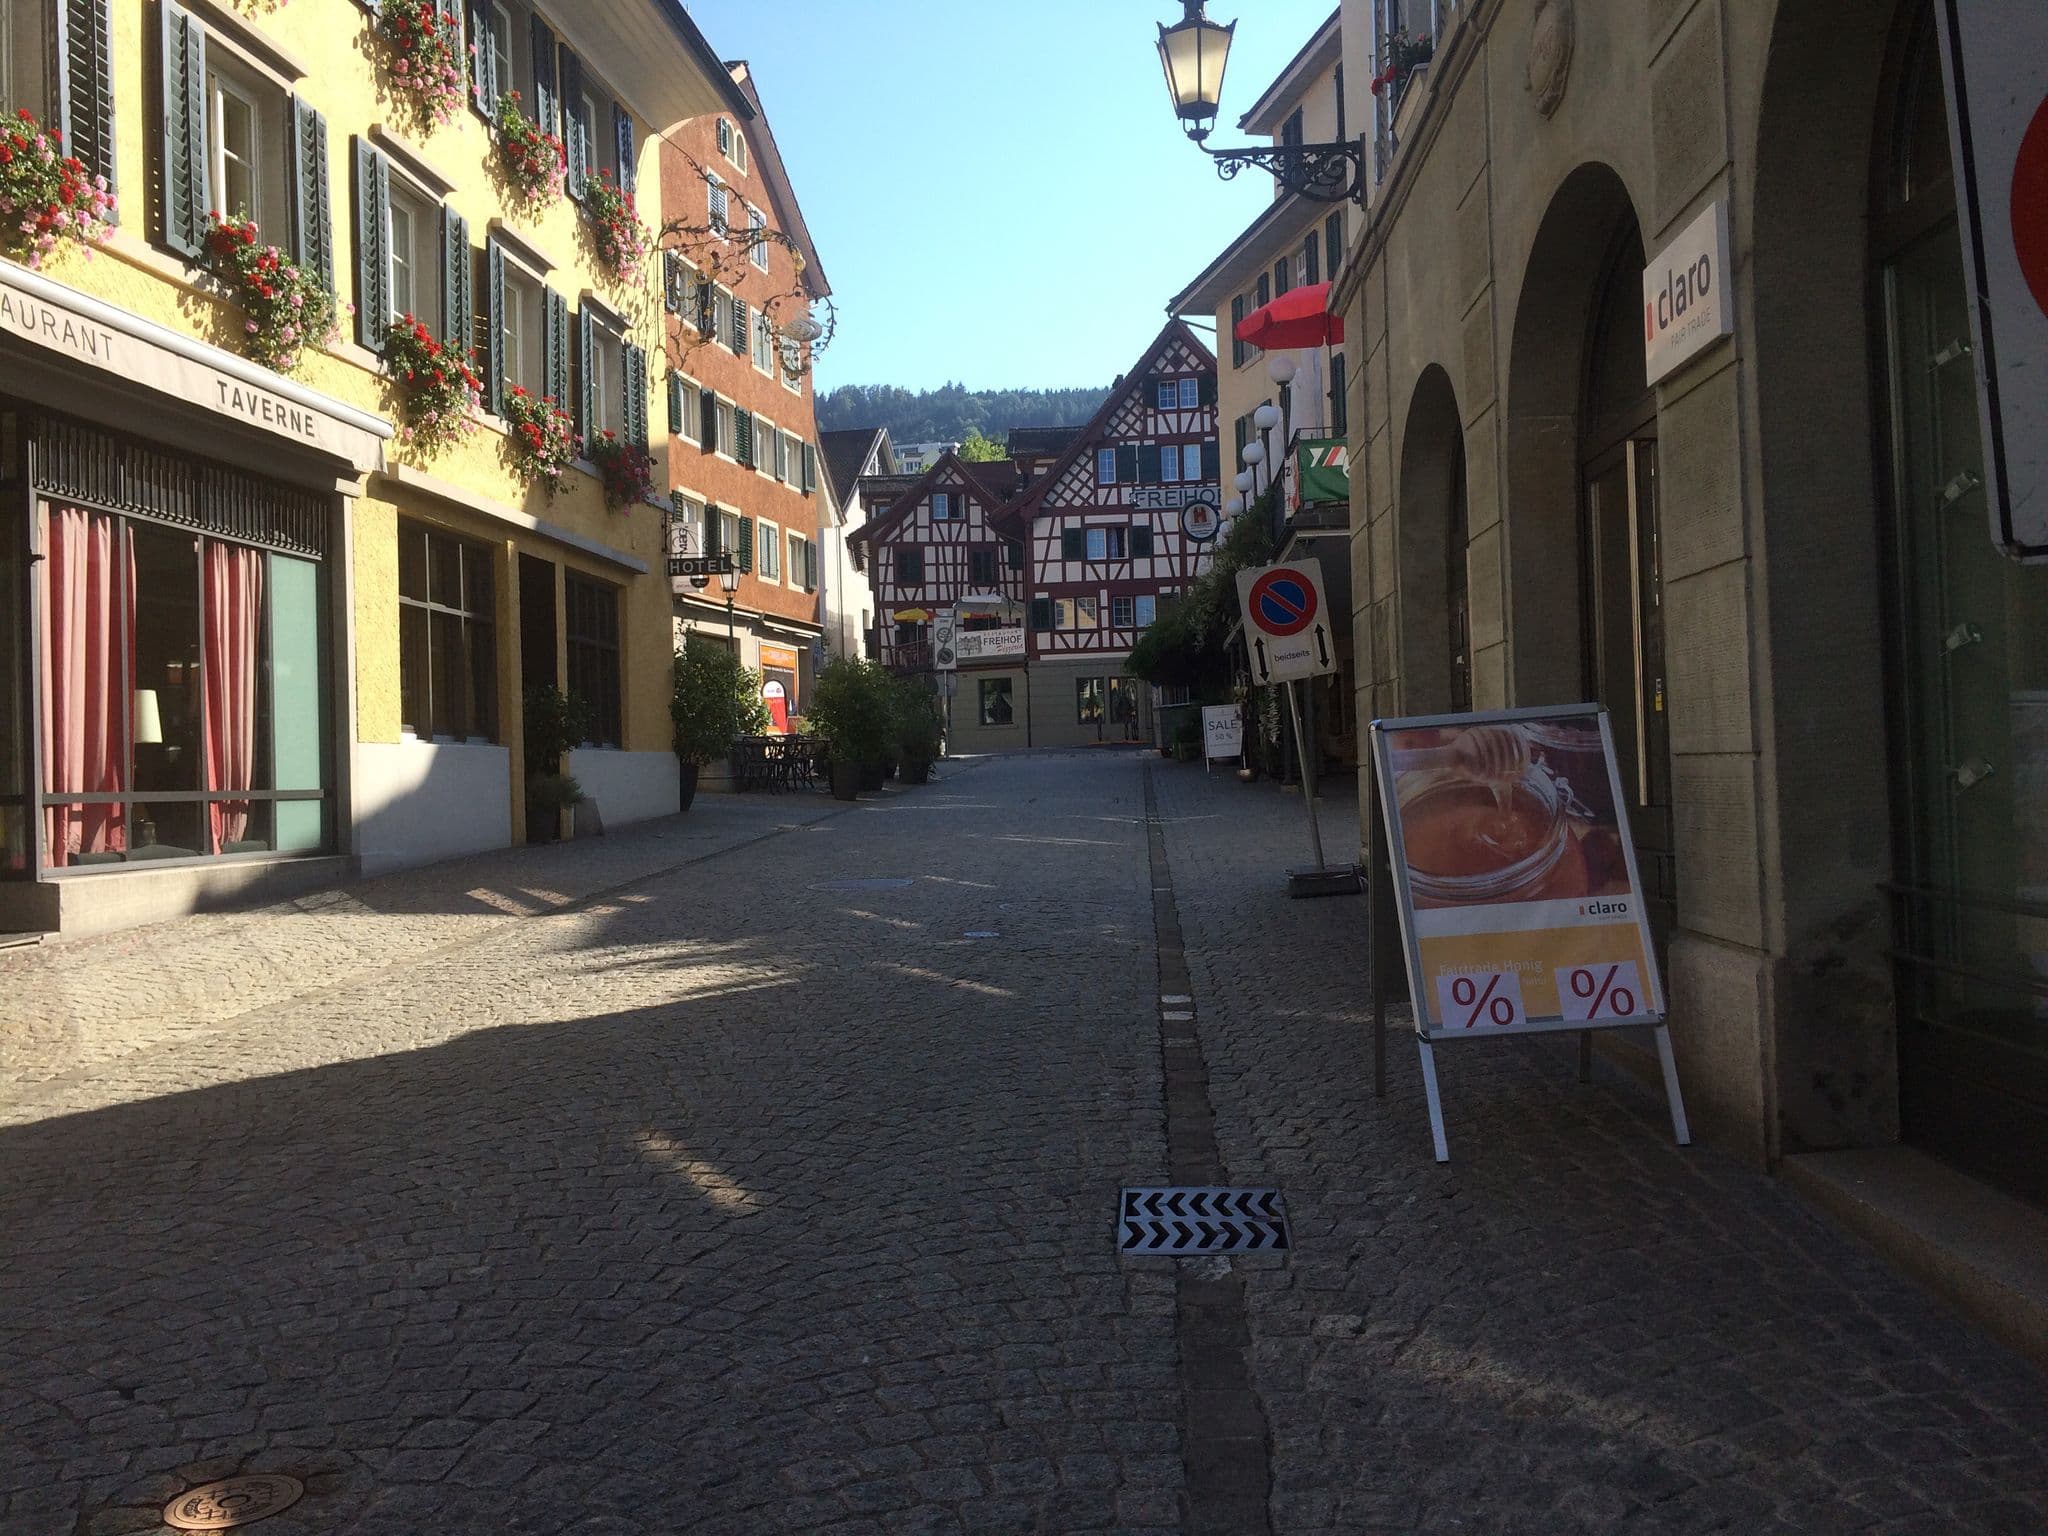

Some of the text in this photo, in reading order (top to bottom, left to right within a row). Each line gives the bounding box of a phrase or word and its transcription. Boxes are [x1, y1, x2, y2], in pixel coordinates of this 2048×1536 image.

[1658, 253, 1711, 330] claro
[217, 379, 316, 438] TAVERNE
[669, 560, 730, 574] HOTEL
[983, 635, 1022, 646] FREIHOF
[1274, 650, 1311, 662] beidseits
[1208, 720, 1238, 731] SALE
[1588, 901, 1628, 915] claro
[1504, 960, 1544, 974] Honig
[1452, 965, 1635, 1028] % %
